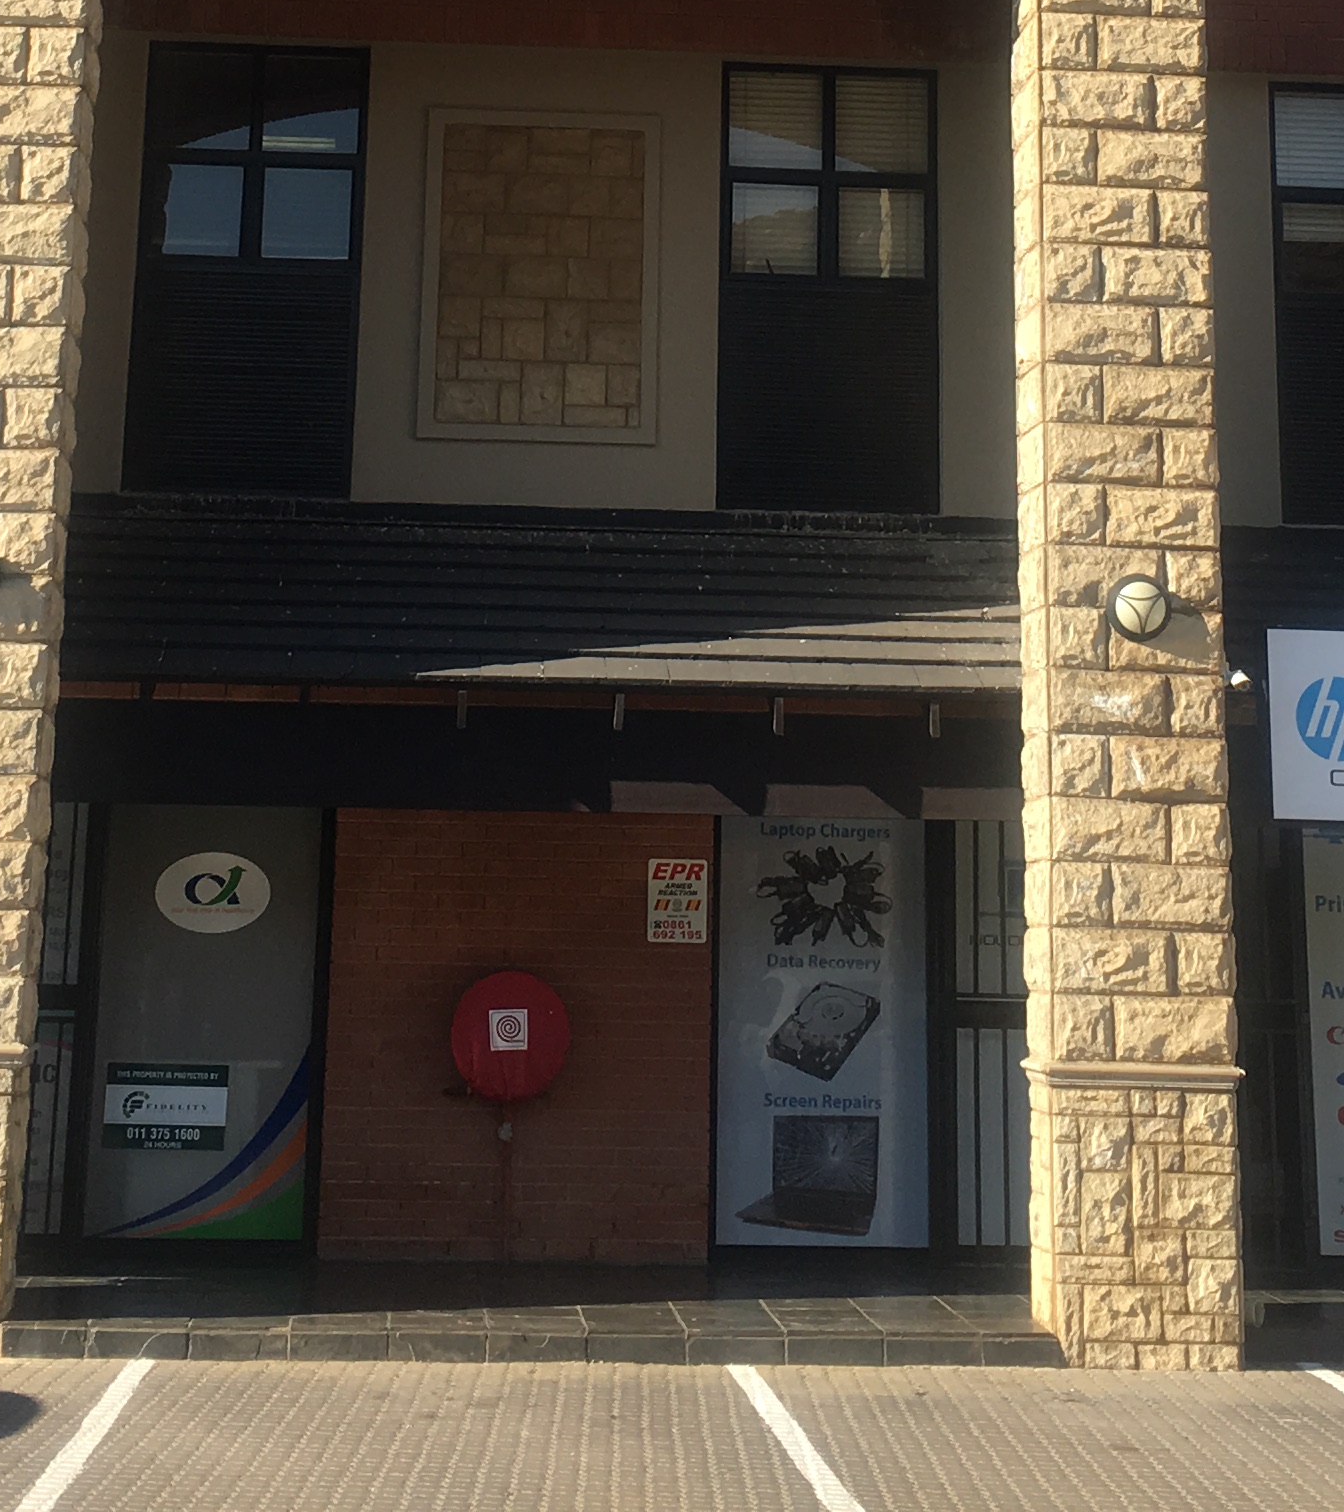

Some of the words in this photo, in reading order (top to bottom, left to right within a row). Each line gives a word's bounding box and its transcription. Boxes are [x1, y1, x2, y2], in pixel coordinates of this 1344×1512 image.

[760, 821, 816, 839] Laptop
[820, 823, 891, 841] Chargers
[652, 862, 705, 881] EPR
[766, 953, 804, 968] Data
[808, 954, 882, 973] Recovery
[763, 1092, 818, 1108] Screen
[822, 1093, 882, 1112] Repairs
[126, 1127, 146, 1140] 011
[150, 1128, 171, 1140] 375
[174, 1128, 201, 1141] 1600
